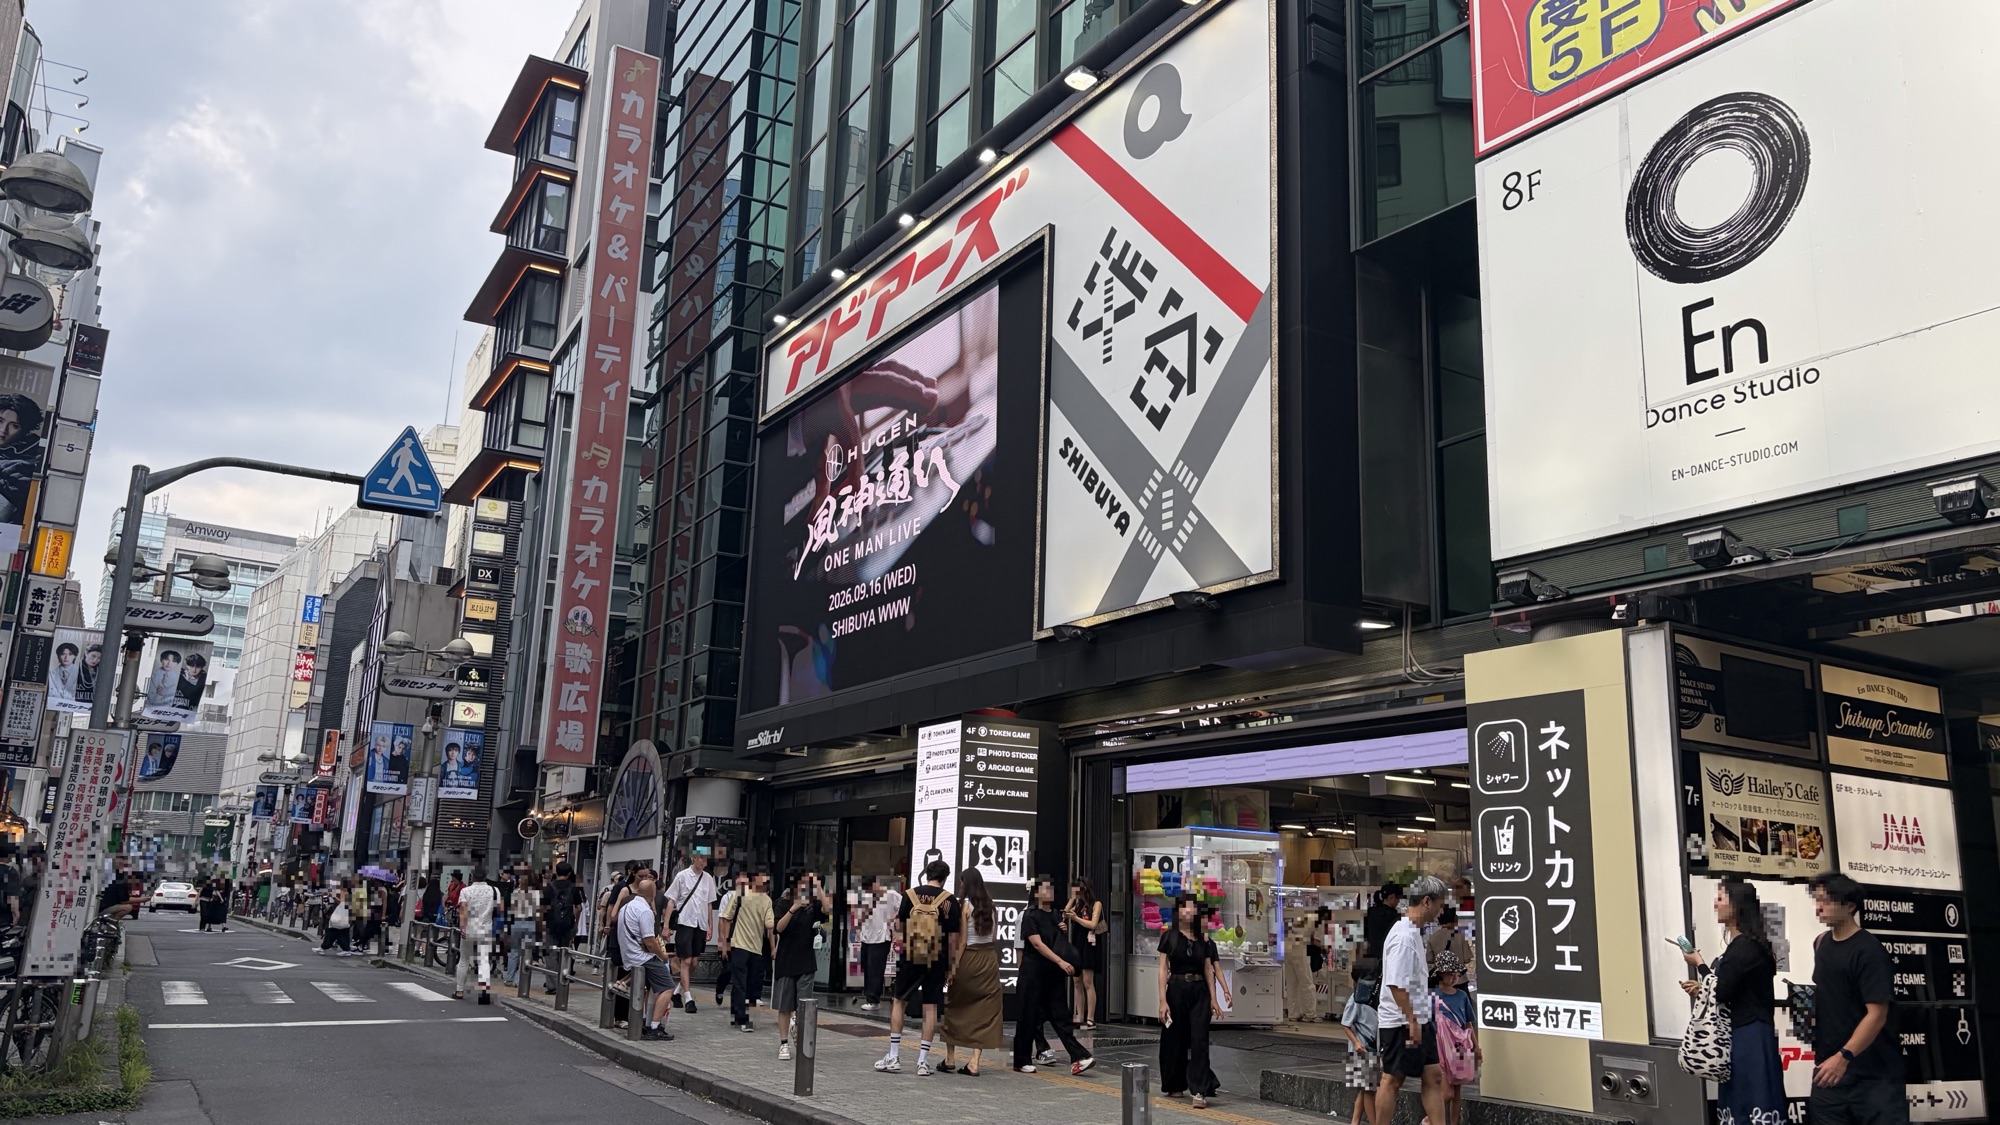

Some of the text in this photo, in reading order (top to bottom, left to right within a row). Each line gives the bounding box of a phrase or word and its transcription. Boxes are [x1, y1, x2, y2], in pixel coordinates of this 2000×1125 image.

[1501, 169, 1542, 211] 8F
[785, 167, 1030, 396] アドアーズ
[79, 334, 89, 342] 7F
[1681, 296, 1769, 386] En
[1645, 366, 1821, 429] Dance Studio
[847, 413, 917, 464] HUGEN
[66, 443, 75, 452] 5
[1671, 441, 1799, 481] EN-DANCE-STUDIO.COM
[1058, 436, 1131, 537] SHIBUYA
[185, 522, 231, 541] Amway
[571, 475, 609, 601] カラオケ
[824, 516, 921, 572] ONE MAN LIVE
[478, 569, 493, 578] DX
[828, 563, 917, 612] 2026.09.16 (WED)
[26, 587, 46, 626] 奈加野
[832, 596, 911, 639] SHIBUYA WWW
[388, 678, 456, 692] 渋谷センター街
[1680, 679, 1716, 691] DANCE STUDIO
[556, 640, 592, 752] 歌広場
[1681, 695, 1708, 706] SCRAMBLE
[1857, 684, 1908, 703] En DANCE STUDIO
[1714, 717, 1725, 733] 8F
[1835, 701, 1935, 740] Shibuya Scramble
[966, 727, 1031, 739] 4F TOKEN GAME
[0, 752, 30, 762] 田中ビル
[932, 747, 960, 758] PHOTO STICKER
[988, 749, 1038, 760] PHOTO STICKER
[931, 763, 947, 771] ARCADE
[988, 765, 1034, 774] ARCADE GAME
[95, 753, 116, 818] 貨物の積卸し
[964, 781, 975, 789] 2F
[1486, 773, 1519, 785] シャワー
[1723, 780, 1730, 791] 5
[930, 787, 954, 797] CLAW CRANE
[986, 789, 1029, 798] CLAW CRANE
[1684, 785, 1700, 806] 7F
[1795, 783, 1820, 802] Café
[1835, 783, 1843, 793] 6F
[44, 786, 57, 814] DOUTOR
[1883, 813, 1925, 851] JMA
[1538, 720, 1582, 972] ネットカフェ
[1870, 841, 1926, 855] Japan Marketing Agency
[1714, 852, 1739, 862] INTERNET
[1490, 861, 1521, 873] ドリンク
[1805, 862, 1819, 870] FOOD
[75, 886, 87, 907] 区間
[1863, 899, 1914, 913] TOKEN GAME
[1864, 913, 1892, 922] メダルゲーム
[1489, 954, 1531, 964] ソフトクリーム
[1902, 973, 1926, 985] GAME
[1484, 1006, 1514, 1022] 24H
[1524, 1005, 1592, 1030] 受付7F
[1788, 1101, 1807, 1124] 4F
